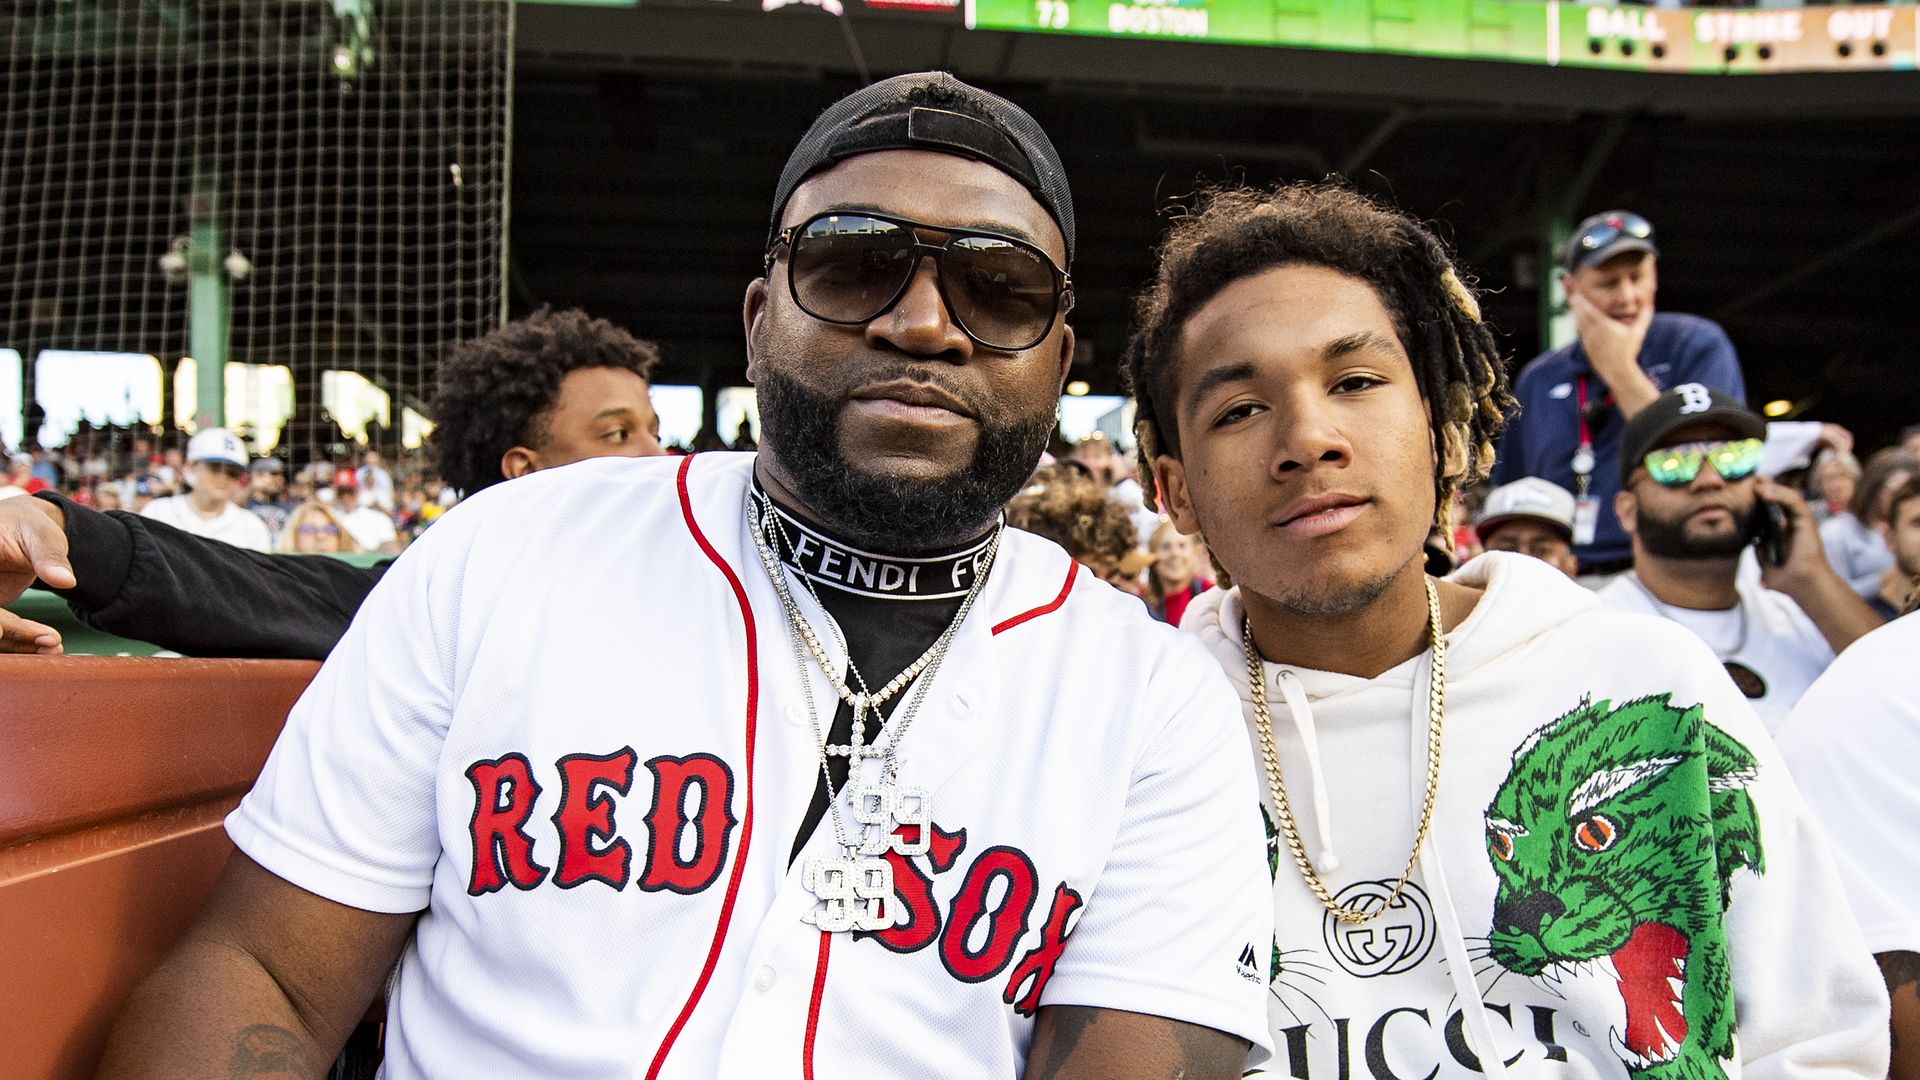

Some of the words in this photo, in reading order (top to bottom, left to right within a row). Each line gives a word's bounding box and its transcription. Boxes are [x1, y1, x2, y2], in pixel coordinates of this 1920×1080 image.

[1036, 0, 1069, 29] 73
[1108, 3, 1208, 37] BOSTON
[1587, 8, 1666, 39] BALL
[1694, 13, 1803, 42] STRIKE
[1827, 9, 1894, 41] OUT
[1673, 382, 1712, 414] B
[791, 532, 921, 593] FENDI
[852, 785, 932, 856] 99
[465, 745, 739, 897] RED
[852, 821, 1084, 1018] SOX
[809, 856, 897, 933] 99
[1243, 1002, 1569, 1080] UCCI
